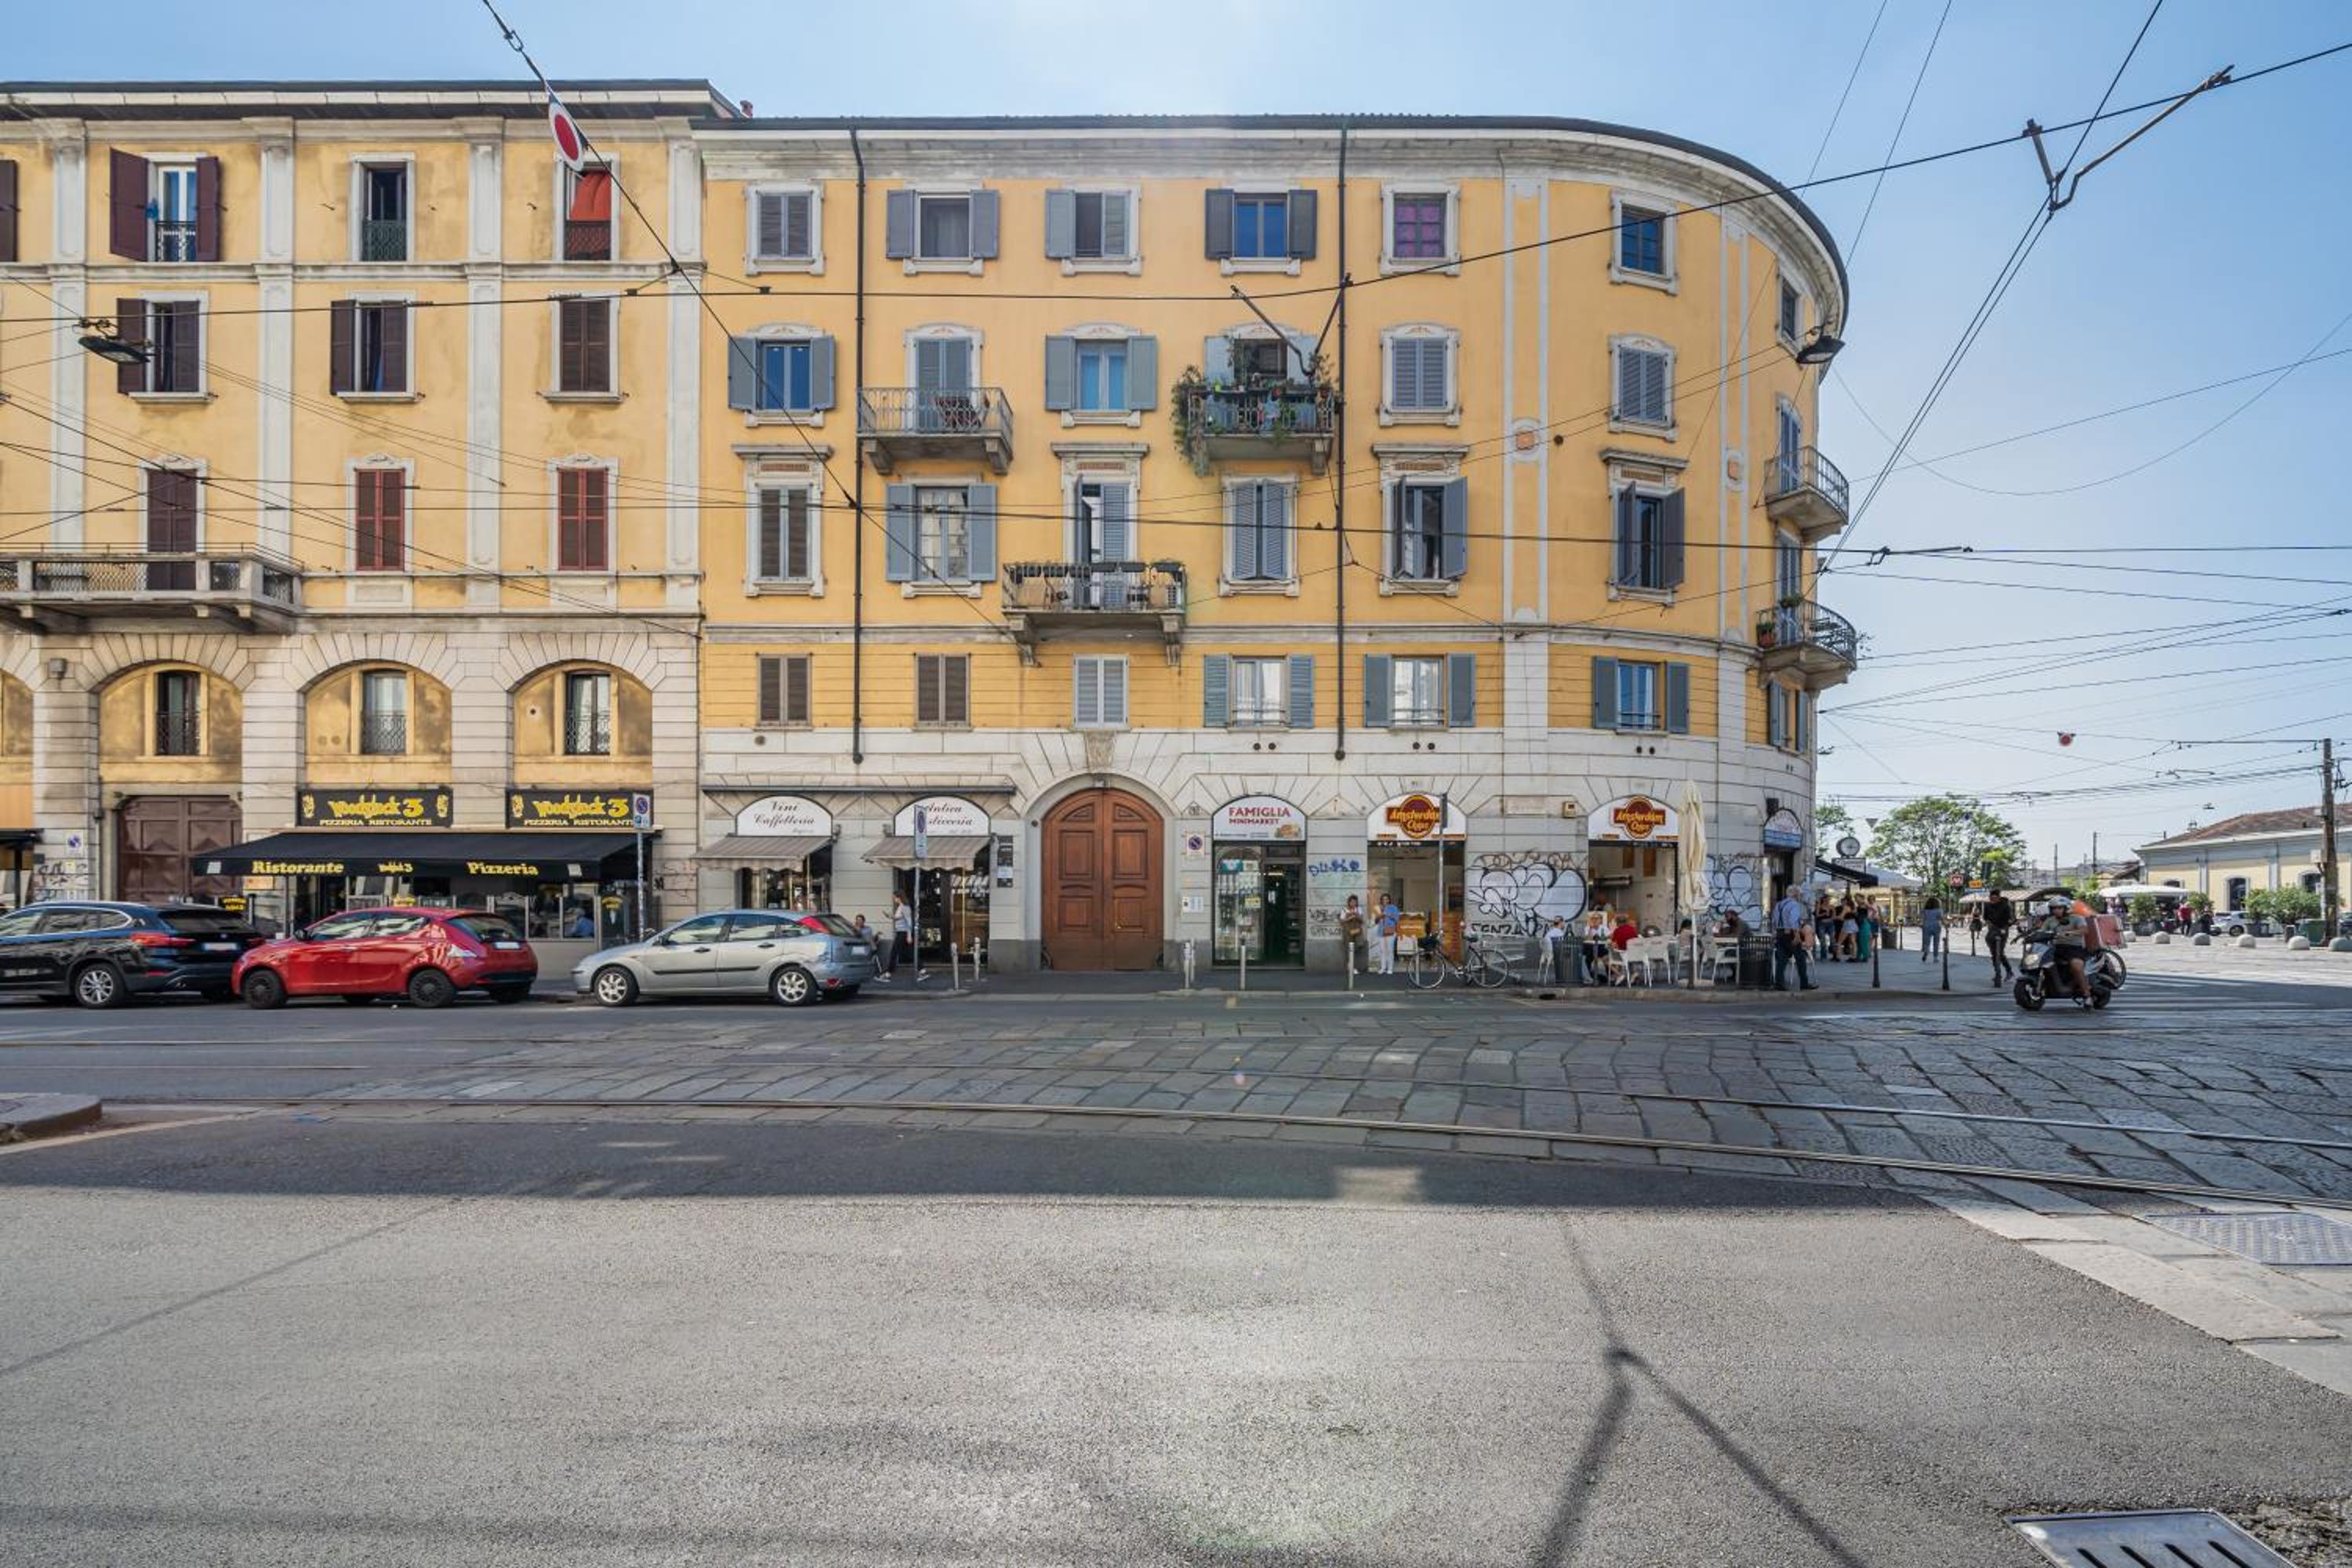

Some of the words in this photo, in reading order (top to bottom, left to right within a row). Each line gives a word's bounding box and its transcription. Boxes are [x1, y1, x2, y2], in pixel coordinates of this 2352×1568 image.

[402, 798, 425, 818] 3
[608, 798, 629, 818] 3
[771, 801, 799, 812] Vini
[1229, 807, 1290, 817] FAMIGLIA
[754, 814, 815, 828] Caffetteria
[1617, 811, 1664, 823] Amsterdam
[252, 860, 344, 874] Ristorante
[466, 861, 539, 876] Pizzeria
